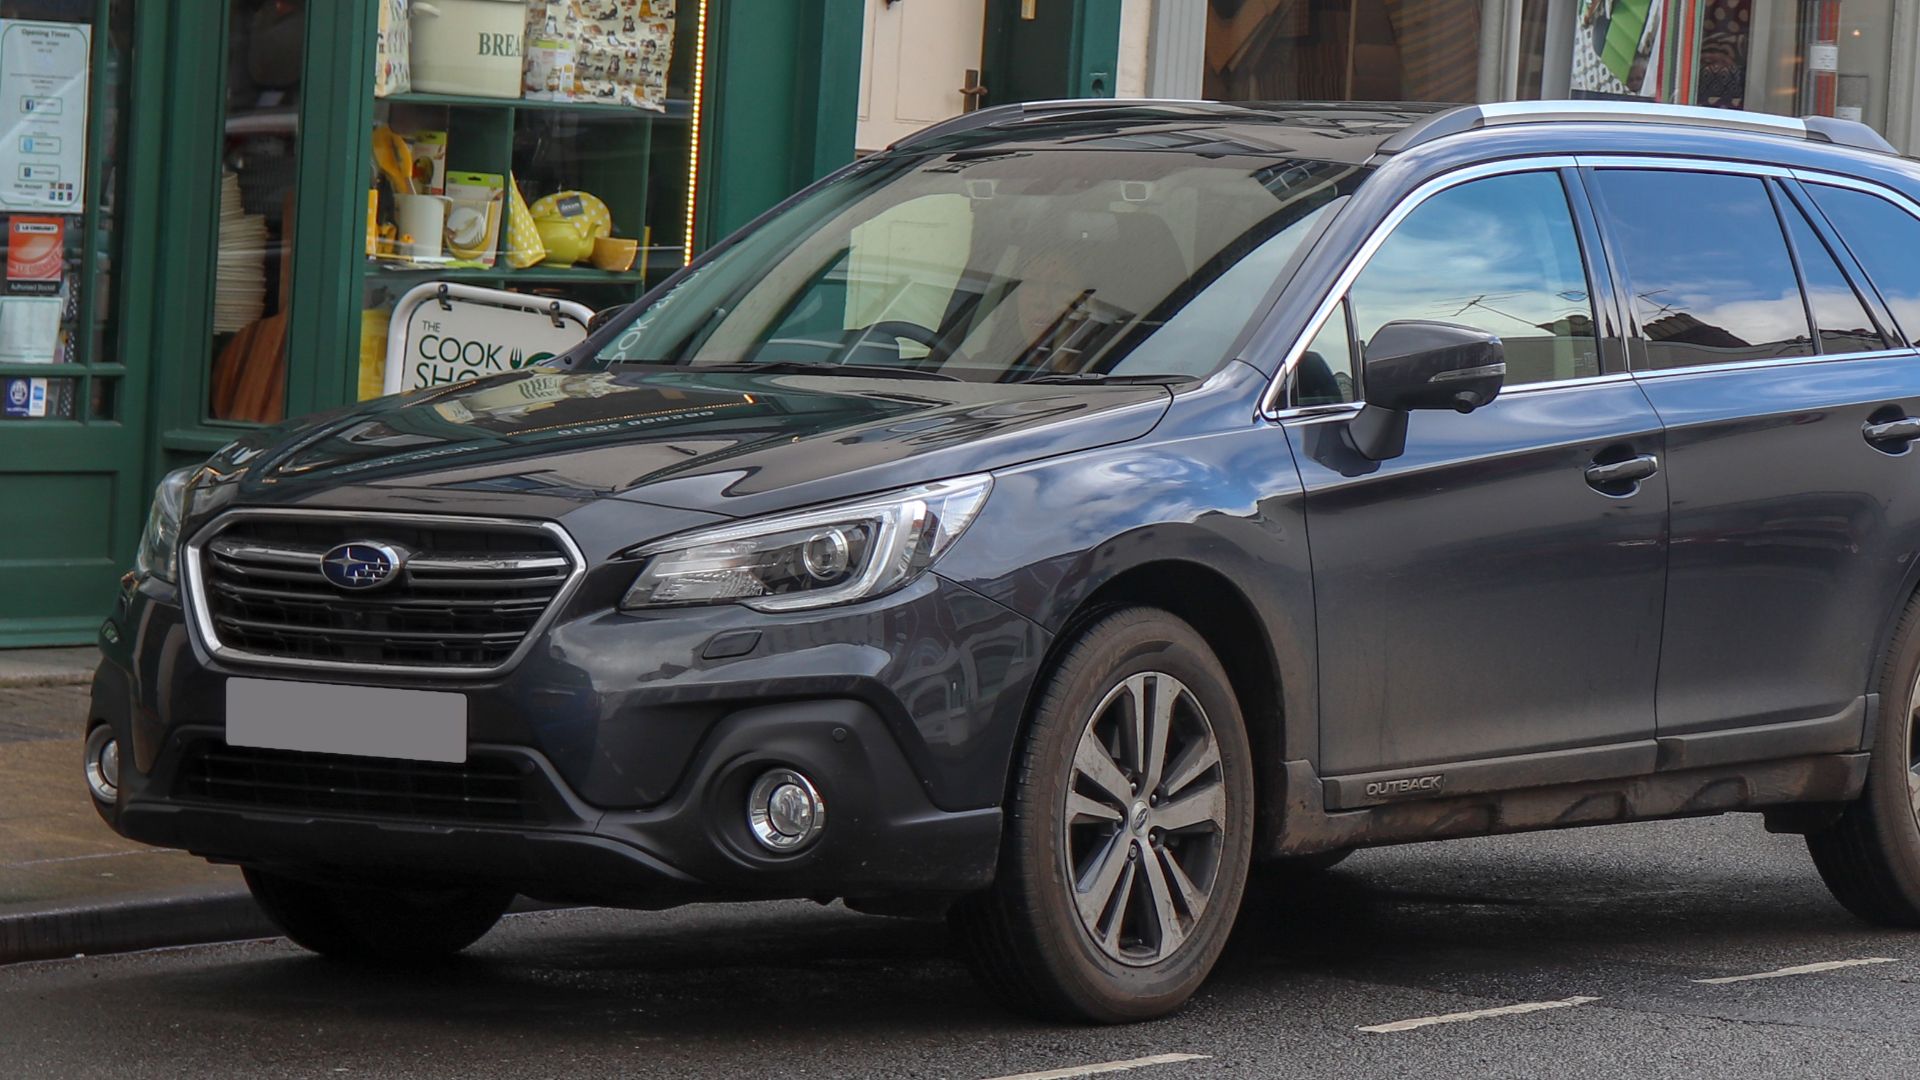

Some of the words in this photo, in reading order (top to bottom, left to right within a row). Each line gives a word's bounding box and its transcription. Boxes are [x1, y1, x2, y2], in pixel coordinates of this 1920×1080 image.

[21, 28, 49, 39] Opening
[51, 30, 71, 39] Times
[422, 320, 441, 333] THE
[419, 334, 504, 371] COOK
[414, 362, 492, 390] SH
[1366, 775, 1442, 796] OUTBACK
